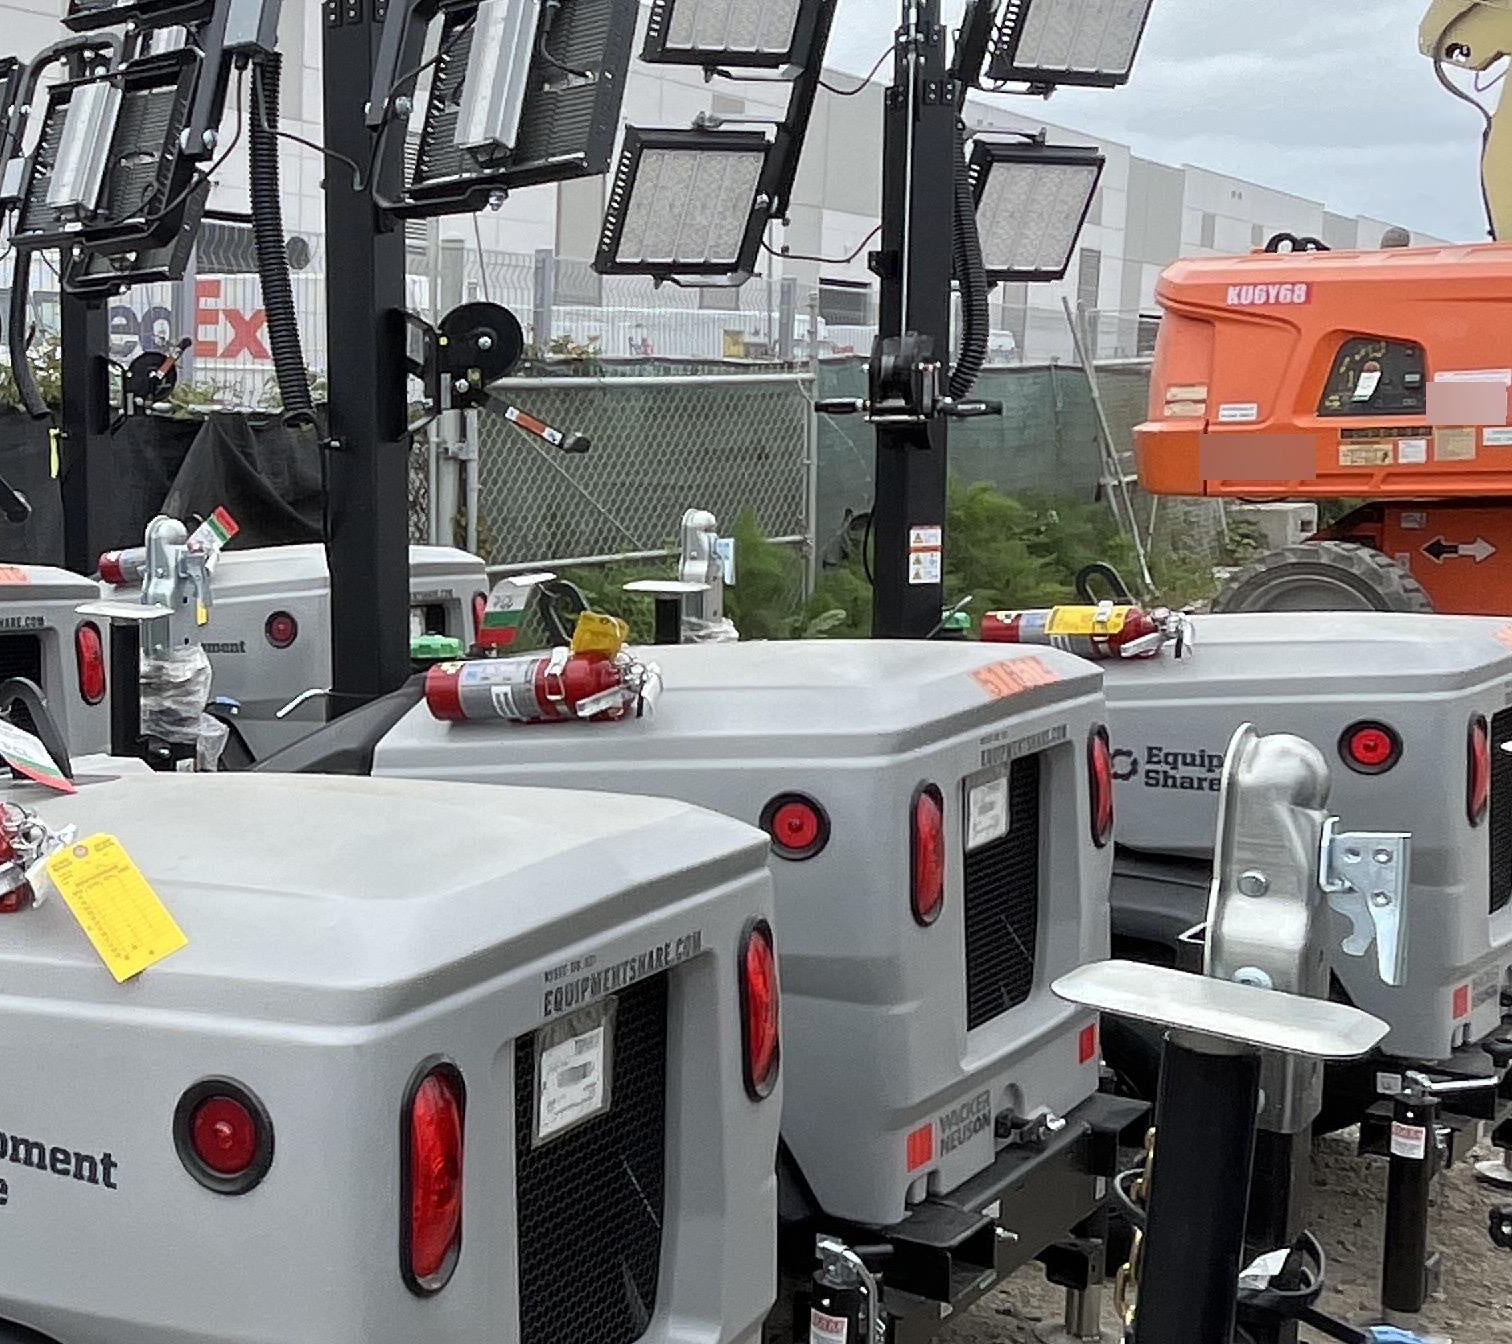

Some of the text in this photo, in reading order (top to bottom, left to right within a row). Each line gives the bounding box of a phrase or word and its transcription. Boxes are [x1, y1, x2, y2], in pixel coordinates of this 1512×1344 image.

[110, 279, 272, 359] edEx
[1144, 768, 1222, 793] Share
[1145, 744, 1224, 773] Equip
[544, 928, 703, 1017] EQUIPMENTSHARE.COM
